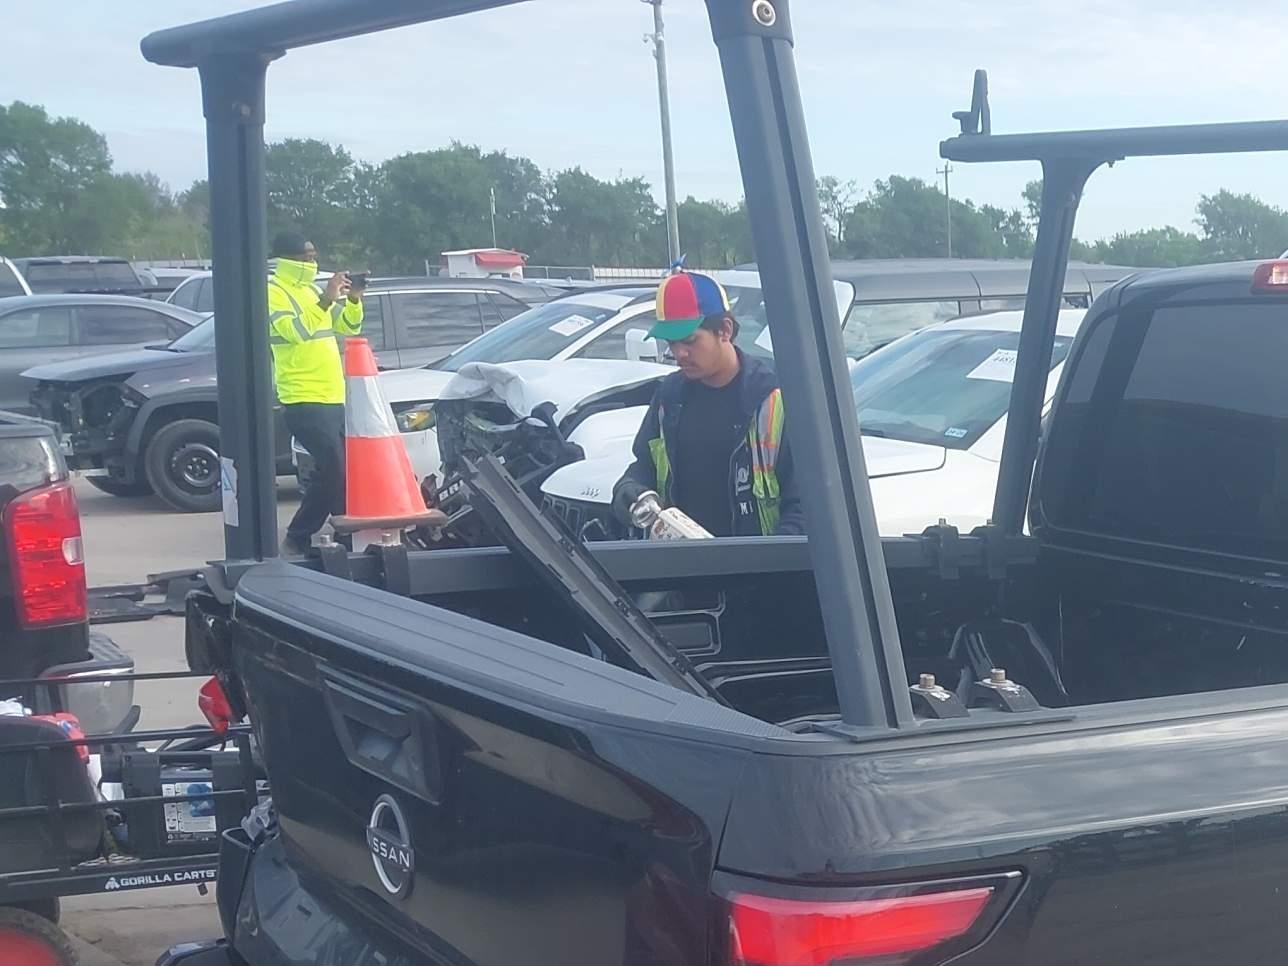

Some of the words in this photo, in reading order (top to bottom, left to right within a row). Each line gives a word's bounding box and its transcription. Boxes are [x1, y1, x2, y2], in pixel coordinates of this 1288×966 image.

[370, 836, 411, 869] SSAN
[119, 873, 172, 887] GORILLA
[173, 869, 217, 881] CARTS
